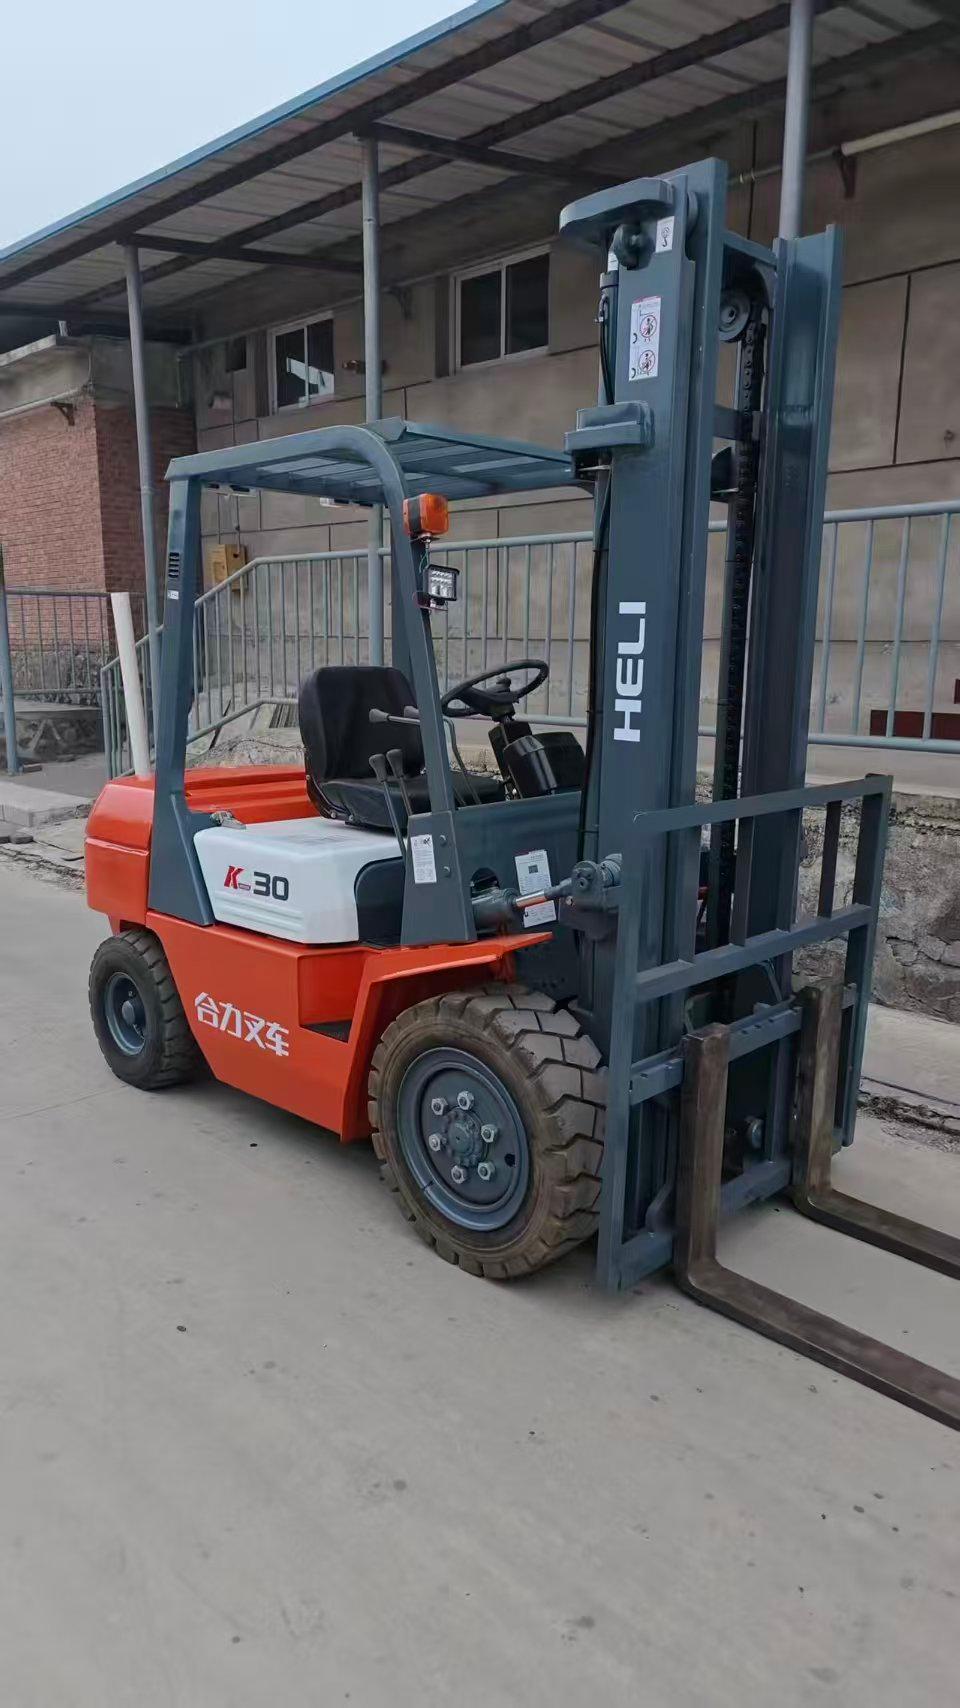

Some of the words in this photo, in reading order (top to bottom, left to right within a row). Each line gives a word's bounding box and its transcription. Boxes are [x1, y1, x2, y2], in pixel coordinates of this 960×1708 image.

[613, 601, 646, 742] HELI
[194, 991, 290, 1057] 合力叉车
